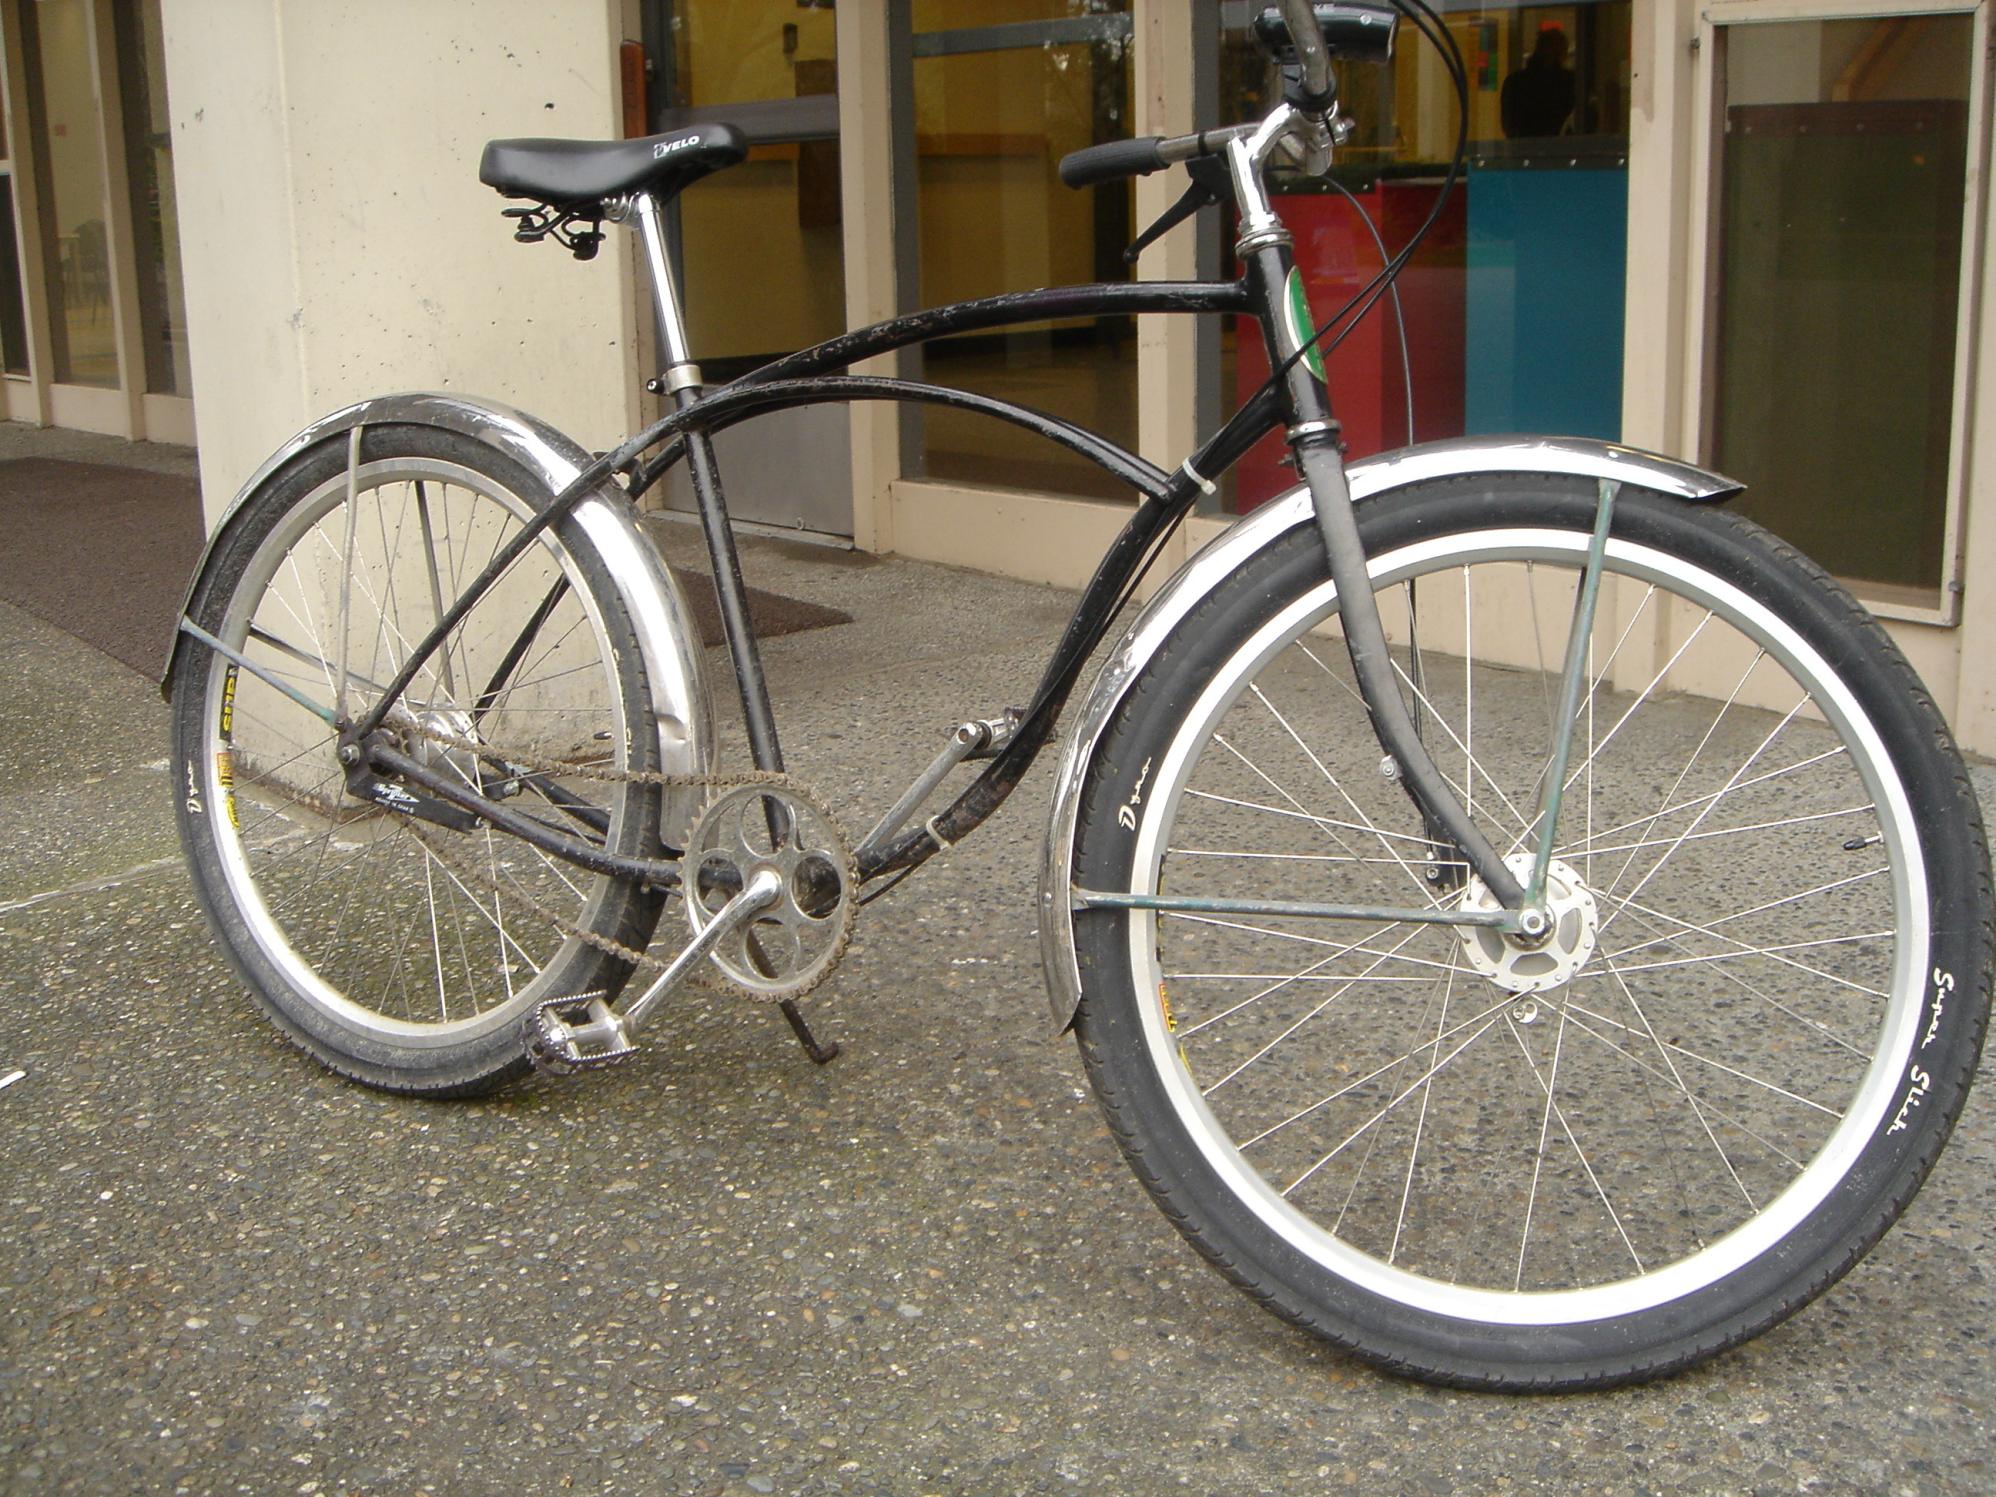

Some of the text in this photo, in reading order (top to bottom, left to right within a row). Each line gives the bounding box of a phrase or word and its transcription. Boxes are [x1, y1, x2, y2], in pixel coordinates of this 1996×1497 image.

[661, 135, 700, 154] VELO
[1886, 967, 1955, 1136] Super Slick
